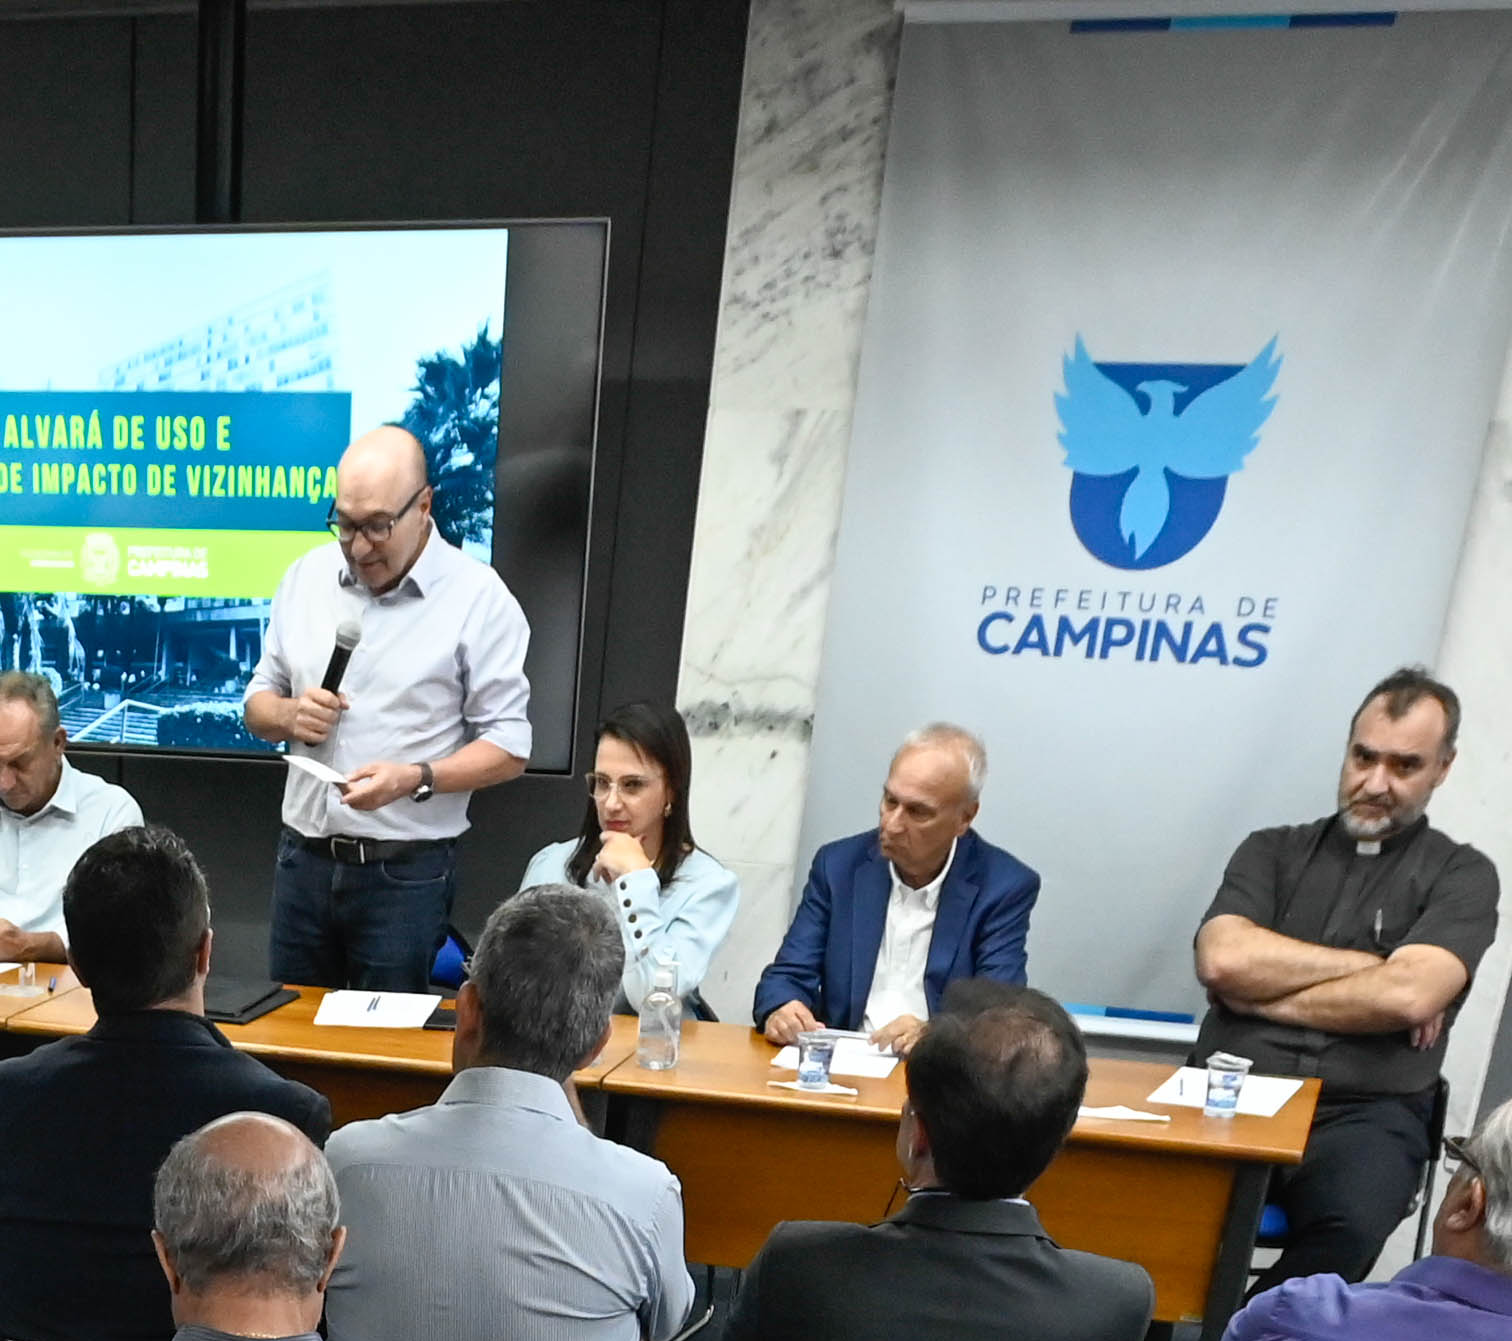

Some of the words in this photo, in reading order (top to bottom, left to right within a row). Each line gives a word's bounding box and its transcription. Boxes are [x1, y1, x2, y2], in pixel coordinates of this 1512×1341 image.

[3, 409, 103, 449] ALVARÁ
[113, 415, 144, 450] DE
[156, 415, 206, 451] USO
[217, 416, 231, 450] E
[32, 463, 137, 495] IMPACTO
[147, 464, 177, 496] DE
[186, 464, 338, 504] VIZINHANÇA
[981, 586, 1205, 614] PREFEITURA
[1236, 596, 1279, 619] DE
[976, 611, 1271, 668] CAMPINAS
